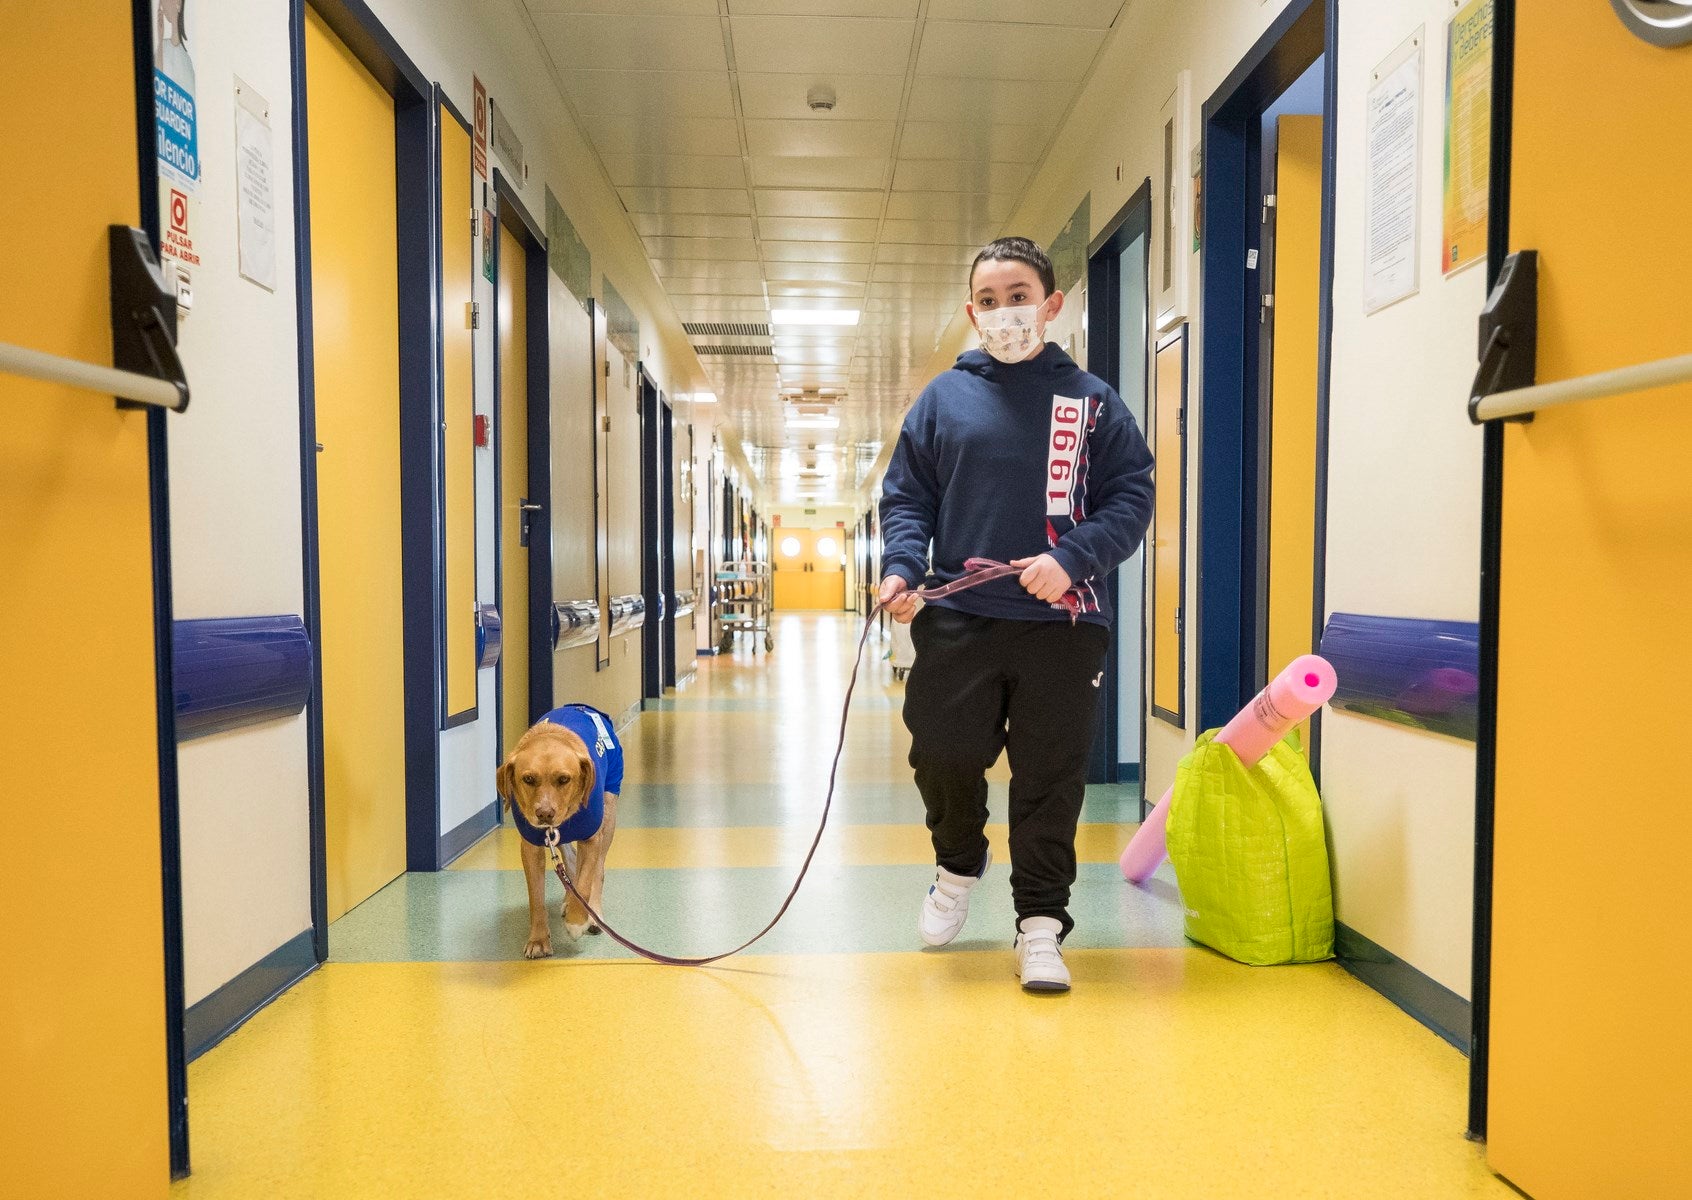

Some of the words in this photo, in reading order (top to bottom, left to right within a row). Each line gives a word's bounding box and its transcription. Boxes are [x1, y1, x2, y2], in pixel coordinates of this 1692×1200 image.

[154, 75, 167, 101] OR
[167, 86, 194, 120] FAVOR
[158, 125, 195, 176] ilencio
[160, 240, 178, 257] PARA
[180, 249, 200, 266] ABRIR
[166, 230, 192, 250] PULSAR
[1049, 405, 1079, 504] 1996
